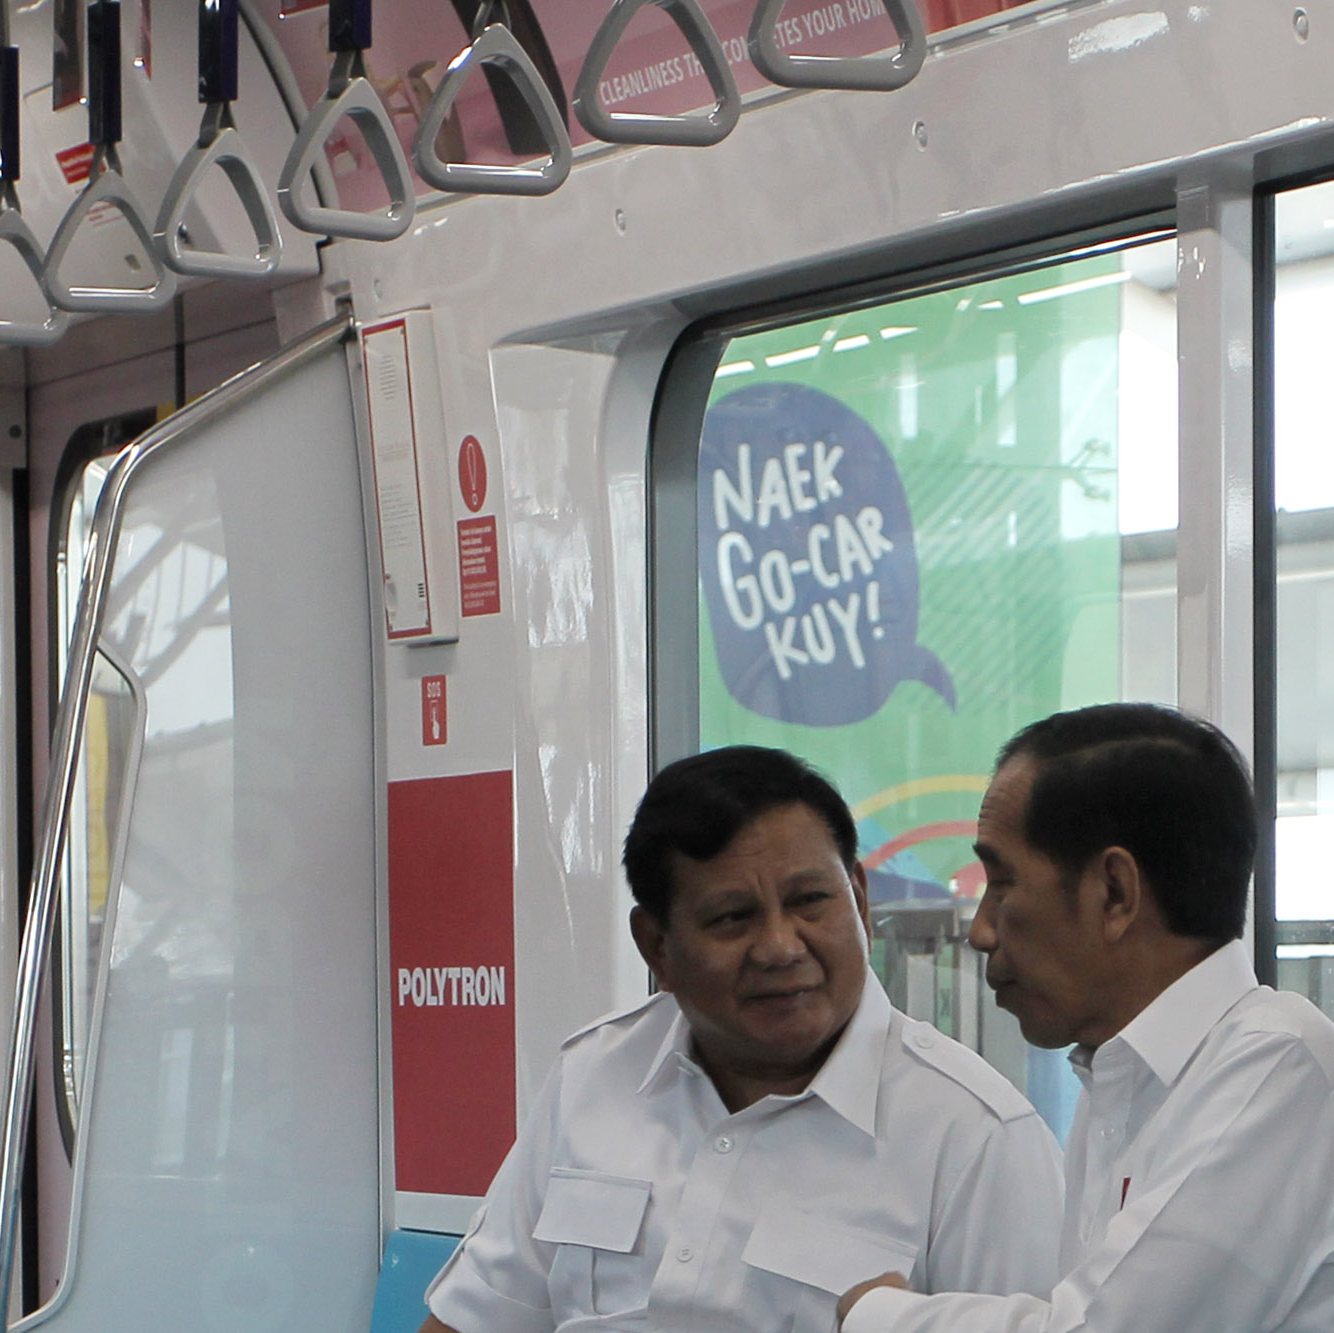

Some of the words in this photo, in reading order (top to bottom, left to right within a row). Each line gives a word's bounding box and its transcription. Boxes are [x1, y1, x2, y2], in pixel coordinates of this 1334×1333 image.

[600, 56, 684, 106] CLEANLINESS
[683, 51, 705, 78] TH
[802, 3, 847, 38] YOUR
[846, 0, 886, 24] HOM
[713, 441, 844, 530] NAEK
[717, 506, 894, 629] GO-CAR
[765, 581, 885, 680] KUY!
[398, 965, 506, 1007] POLYTRON
